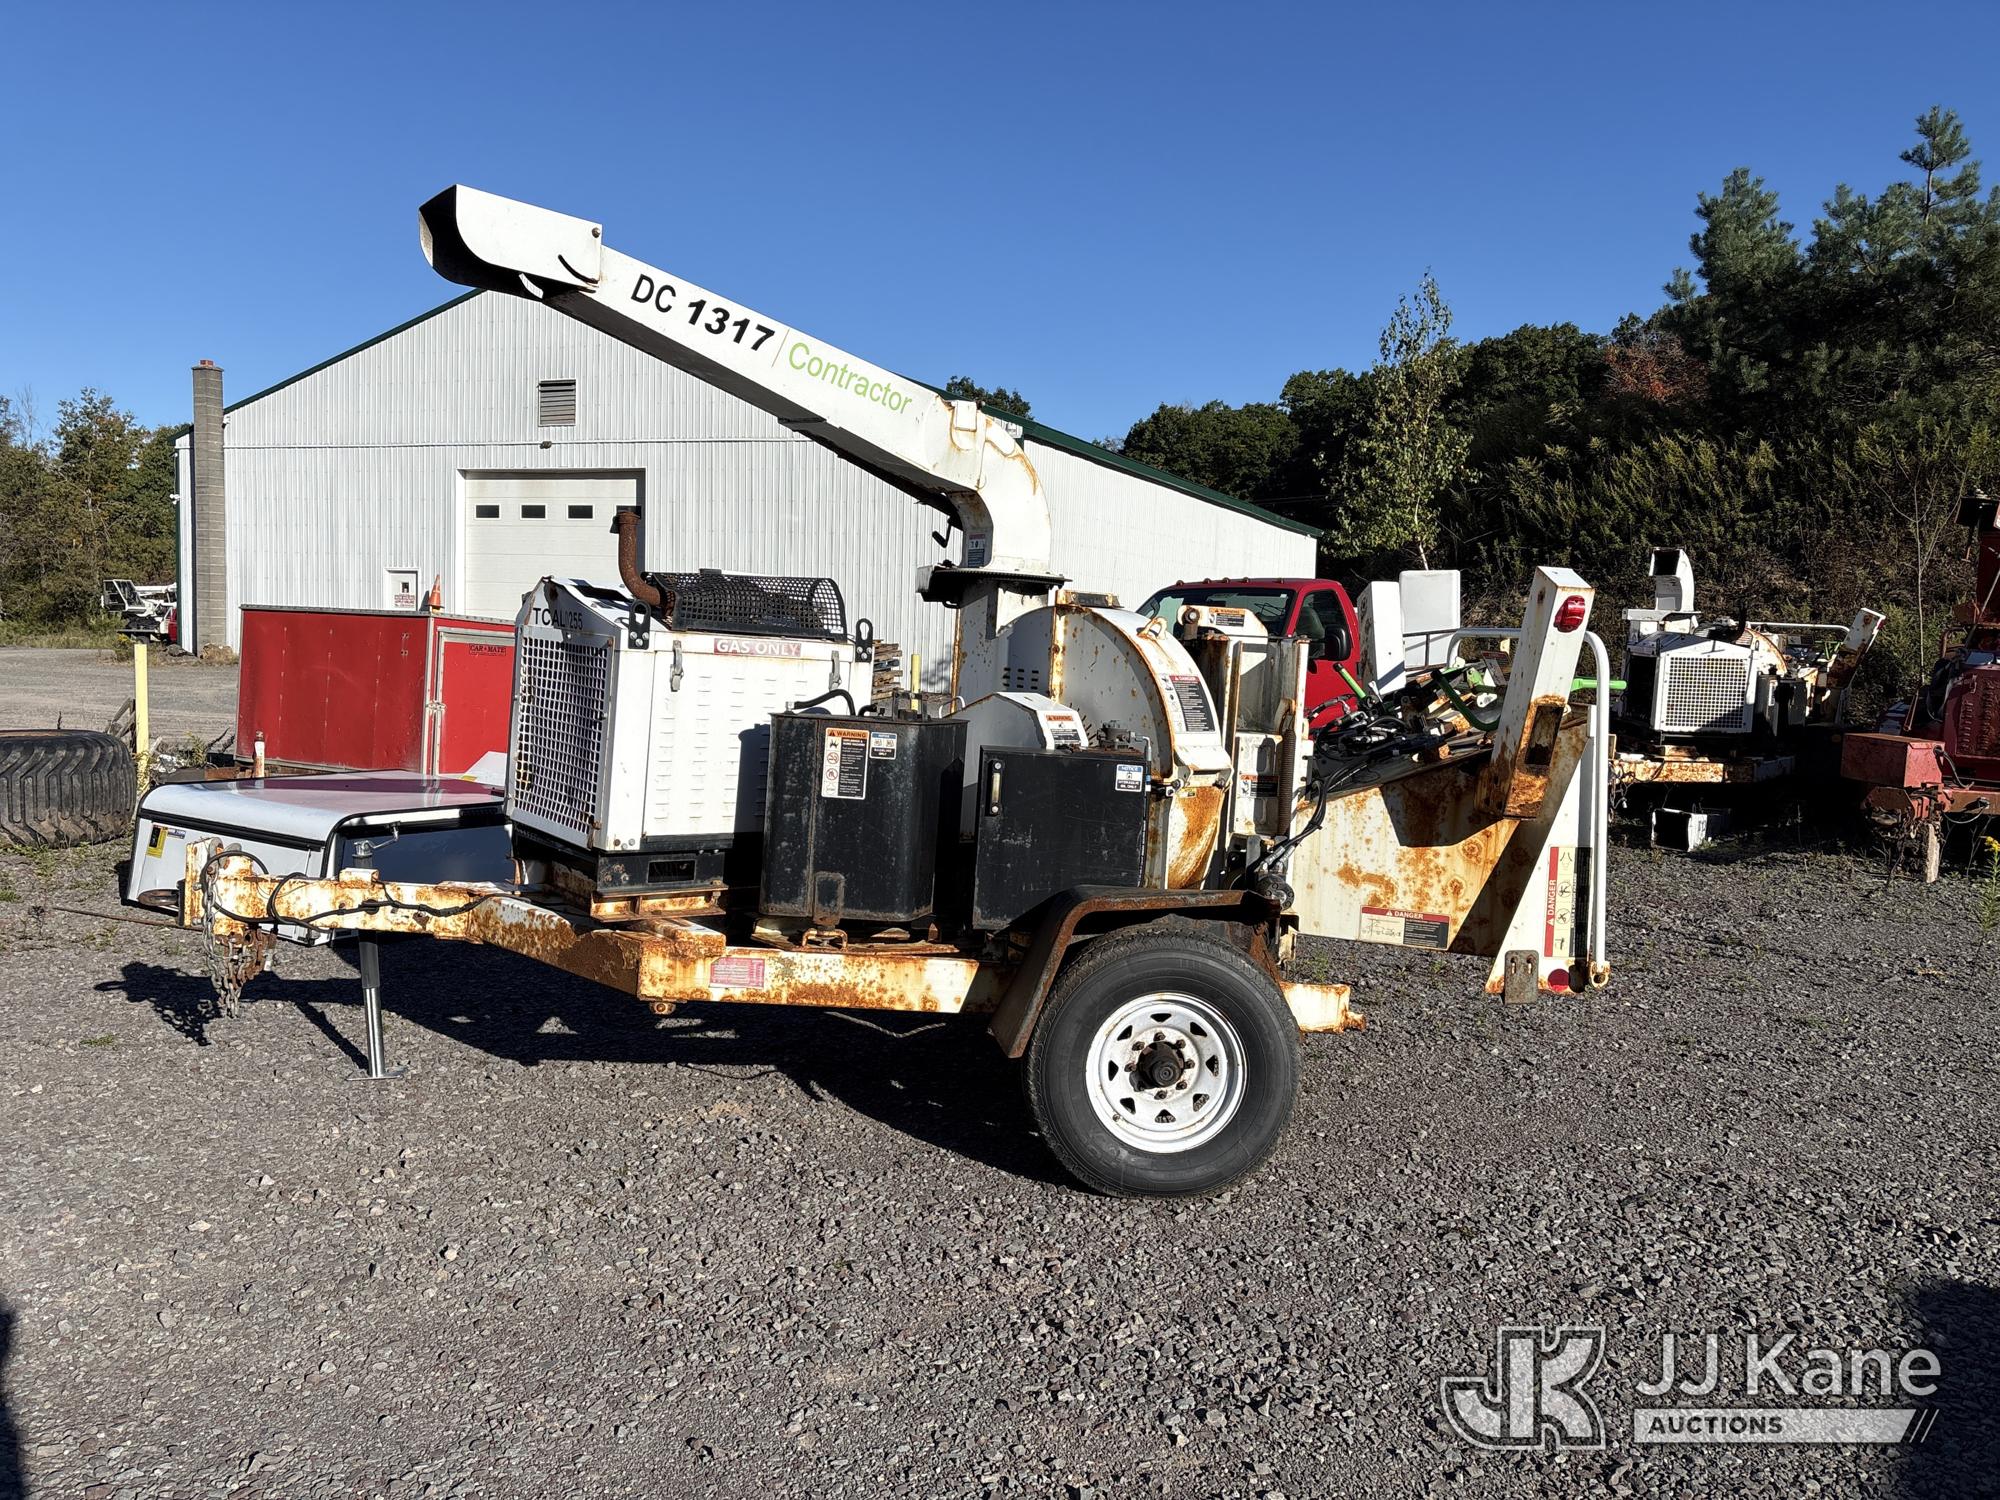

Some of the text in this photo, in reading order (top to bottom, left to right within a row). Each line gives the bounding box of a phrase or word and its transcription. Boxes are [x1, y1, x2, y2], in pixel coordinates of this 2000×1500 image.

[630, 273, 913, 415] DC 1317 Contractor
[716, 639, 799, 656] GAS ONLY
[836, 730, 867, 738] WARNING
[1548, 879, 1557, 916] DANGER
[1394, 911, 1424, 920] DANGER
